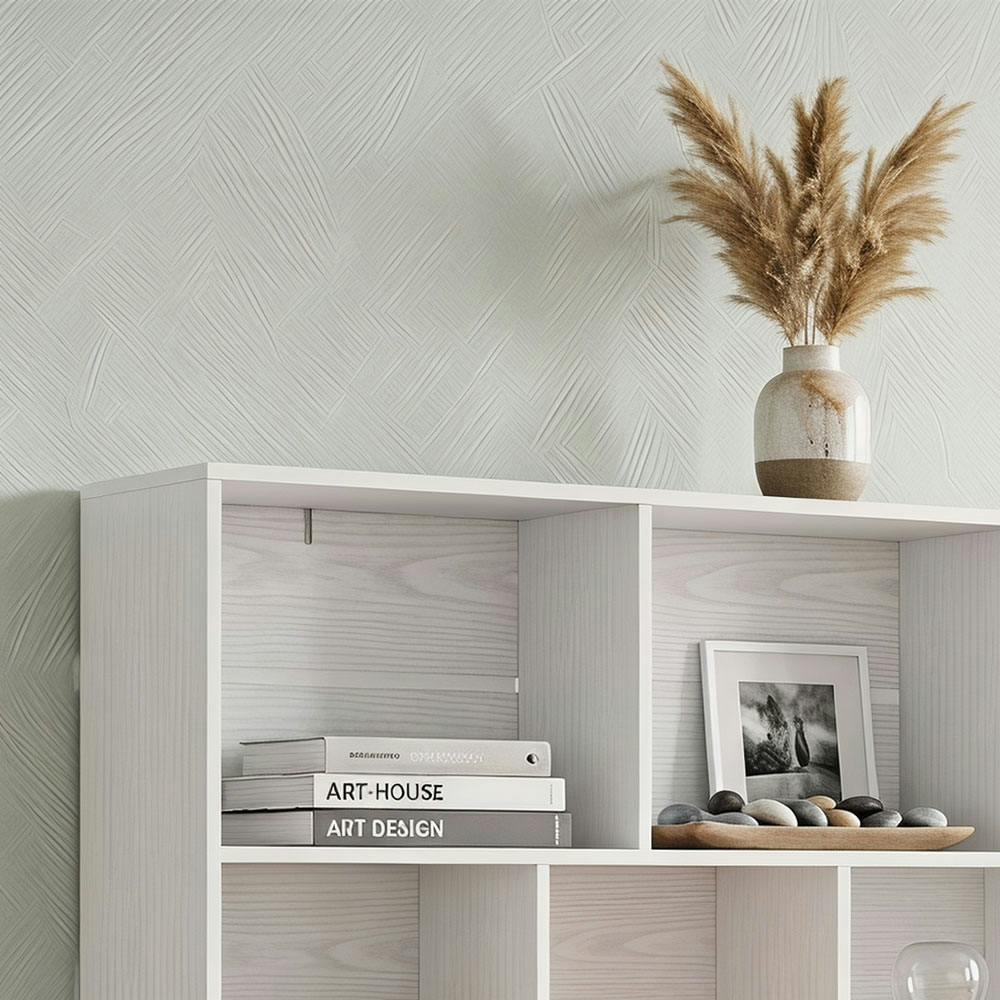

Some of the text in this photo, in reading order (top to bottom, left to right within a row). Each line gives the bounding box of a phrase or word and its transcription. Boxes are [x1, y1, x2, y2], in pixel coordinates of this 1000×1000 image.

[326, 782, 444, 801] ART-HOUSE
[326, 818, 444, 838] ART DESIGN
